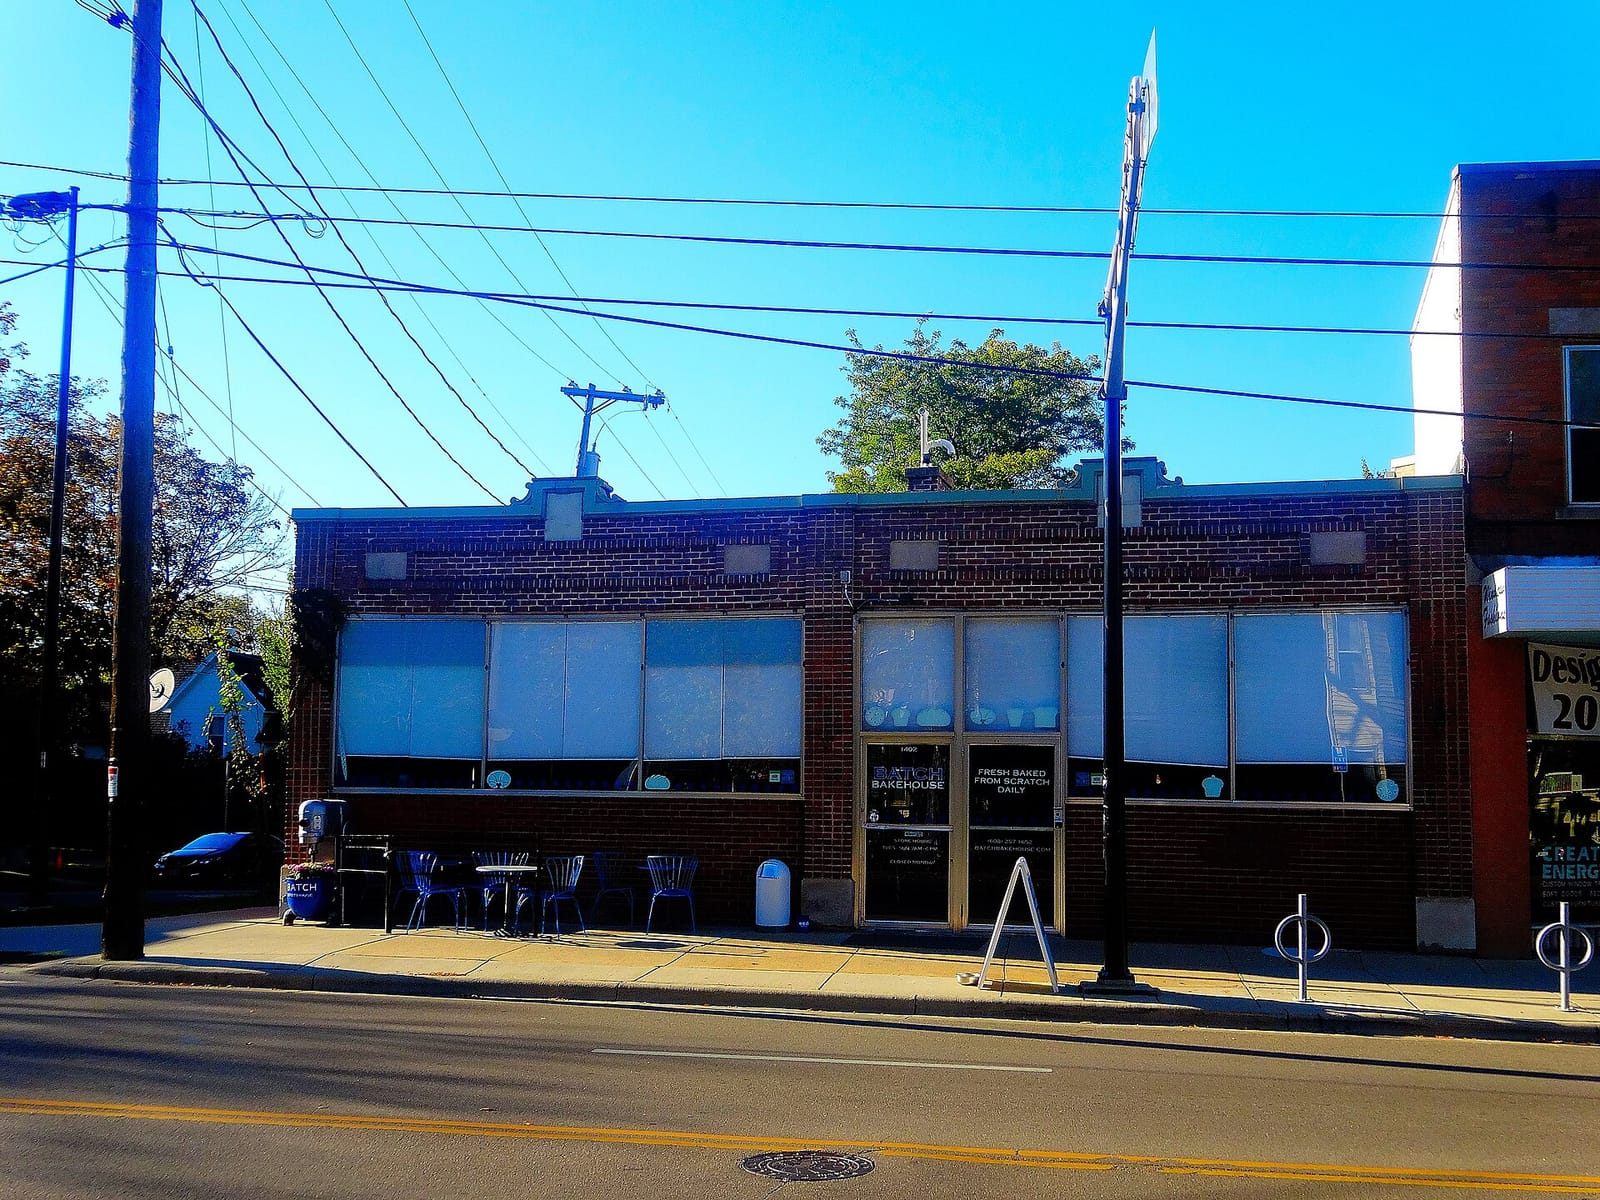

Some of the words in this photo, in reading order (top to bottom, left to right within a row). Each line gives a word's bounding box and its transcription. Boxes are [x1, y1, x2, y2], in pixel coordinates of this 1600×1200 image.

[873, 766, 944, 781] BATCH
[978, 768, 1010, 776] FRESH
[1012, 769, 1046, 777] BAKED
[871, 780, 945, 790] BAKEHOUSE
[974, 776, 1001, 784] FROM
[1003, 777, 1050, 786] SCRATCH
[997, 786, 1026, 794] DAILY
